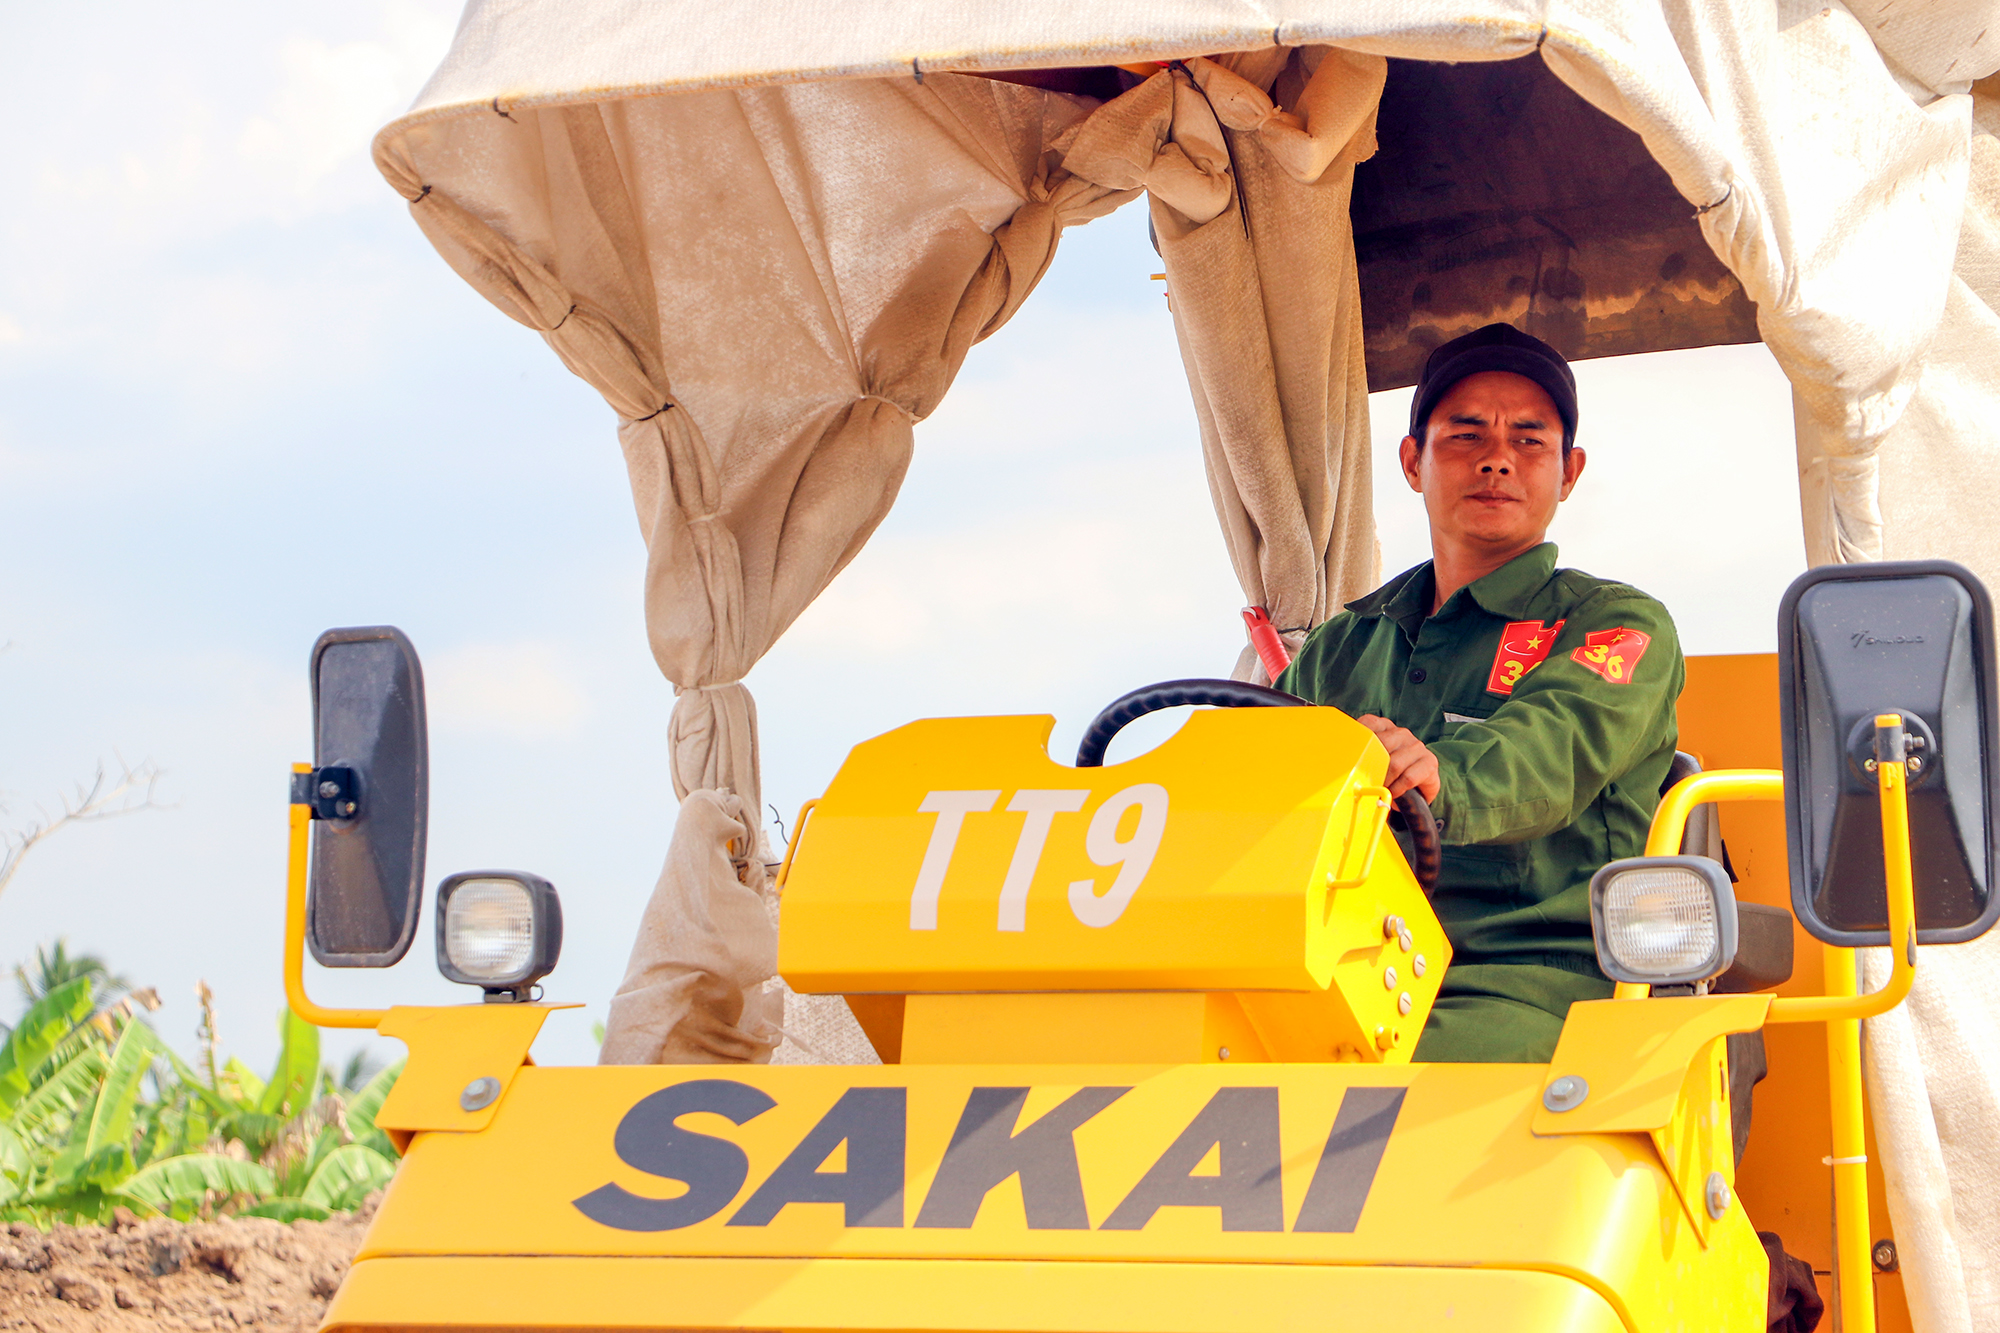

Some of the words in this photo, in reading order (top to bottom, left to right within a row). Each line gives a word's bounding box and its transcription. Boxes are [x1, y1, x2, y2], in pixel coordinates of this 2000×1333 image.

[1499, 660, 1542, 686] 3
[1584, 644, 1625, 679] 36
[909, 783, 1170, 932] TT9
[571, 1078, 1408, 1232] SAKAI
